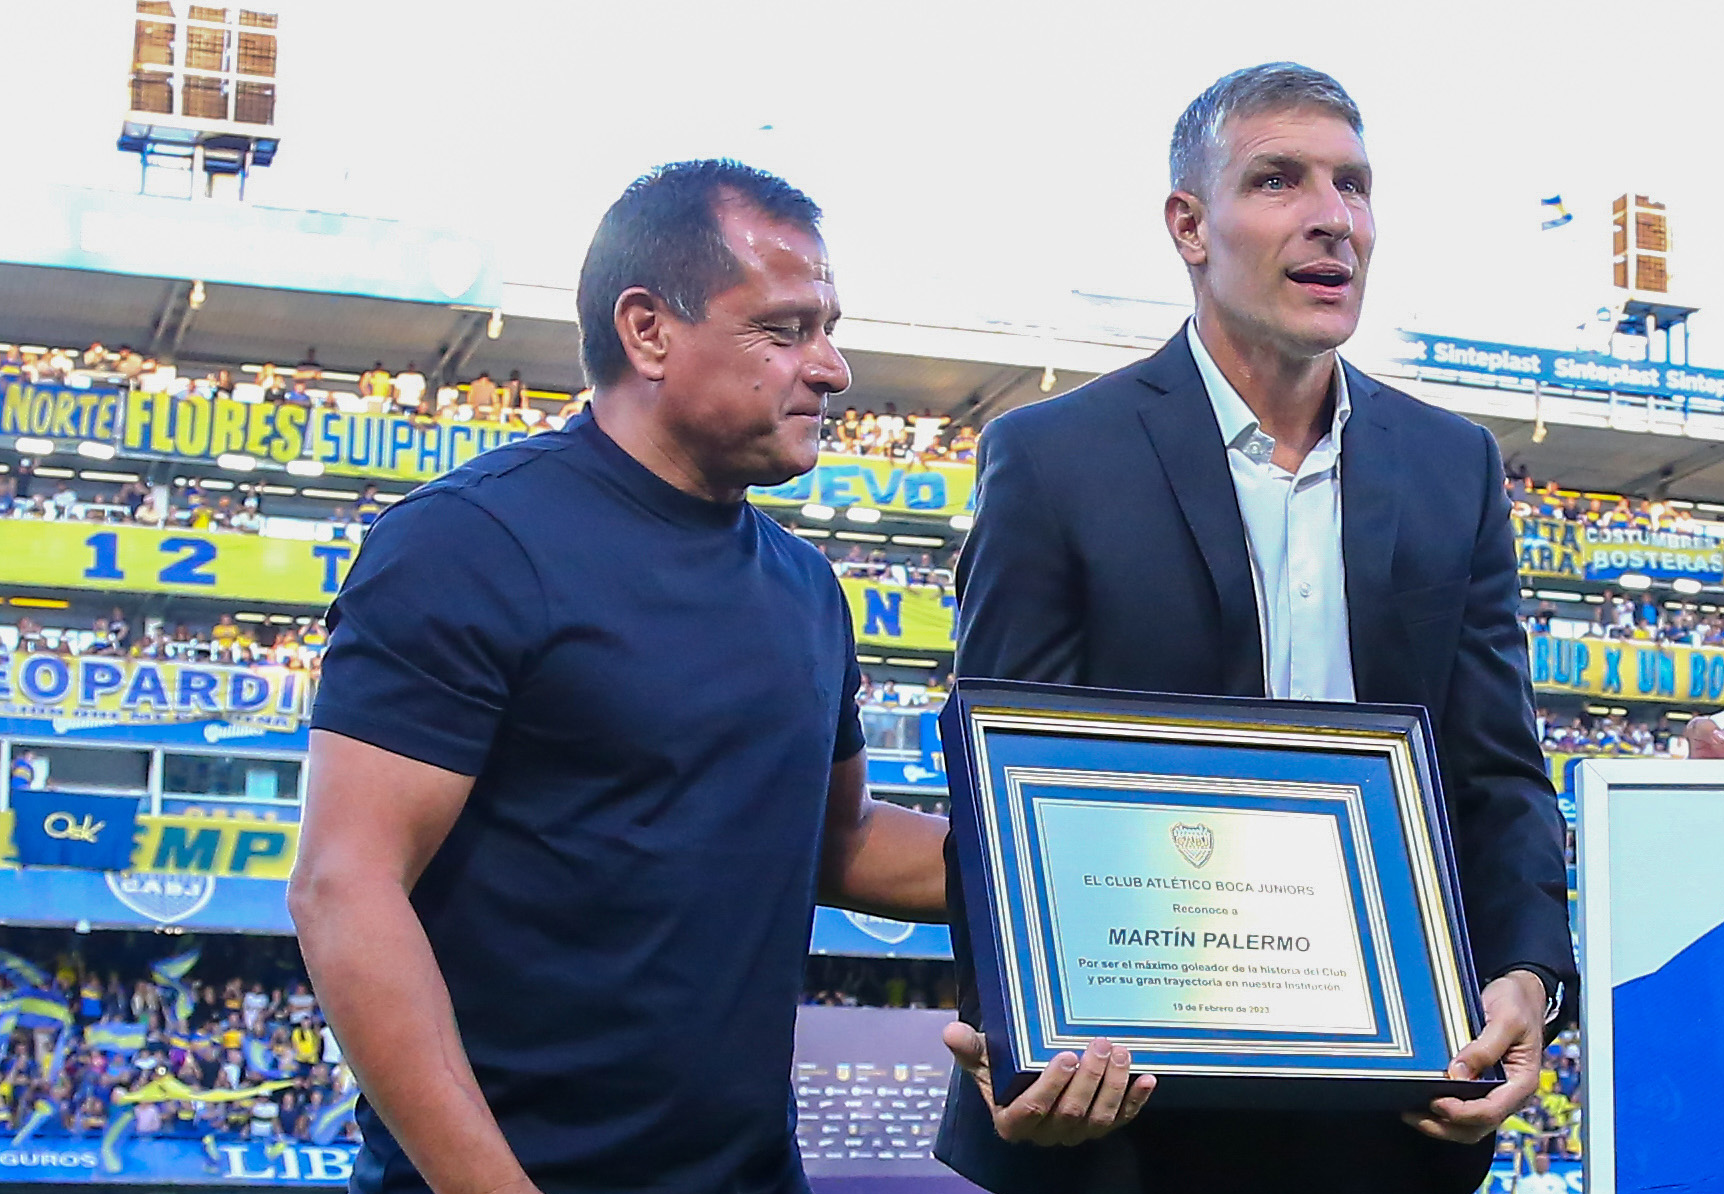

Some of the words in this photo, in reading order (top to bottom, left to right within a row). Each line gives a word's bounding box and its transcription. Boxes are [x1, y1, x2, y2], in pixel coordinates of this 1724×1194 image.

[1434, 341, 1541, 373] Sinteplast
[1554, 357, 1660, 388] Sinteplast
[2, 382, 117, 439] NORTE
[124, 391, 306, 462] FLORES
[1593, 549, 1724, 573] BOSTERAS
[1604, 647, 1622, 693] X
[1637, 649, 1676, 697] UN
[1083, 875, 1101, 886] EL
[1105, 876, 1143, 888] CLUB
[1146, 876, 1211, 890] ATLÉTICO
[1216, 881, 1254, 893] BOCA
[1258, 884, 1315, 896] JUNIORS
[1172, 903, 1228, 915] Reconoce
[1232, 908, 1238, 916] a
[1108, 926, 1195, 948] MARTÍN
[1203, 932, 1311, 952] PALERMO
[1078, 958, 1099, 969] Por
[1101, 960, 1119, 969] ser
[1122, 960, 1132, 970] el
[1135, 961, 1178, 971] máximo
[1181, 963, 1229, 973] goleador
[1232, 964, 1245, 973] de
[1248, 965, 1258, 974] la
[1260, 965, 1301, 975] historia
[1304, 967, 1320, 976] del
[1322, 968, 1347, 978] Club
[1087, 975, 1095, 985] y
[1098, 975, 1117, 985] por
[1119, 976, 1133, 985] su
[1136, 977, 1161, 987] gran
[1164, 976, 1223, 988] trayectoria
[1226, 980, 1239, 988] en
[1242, 980, 1282, 989] nuestra
[1186, 1003, 1197, 1011] de
[1199, 1004, 1234, 1013] Febrero
[1236, 1005, 1247, 1013] de
